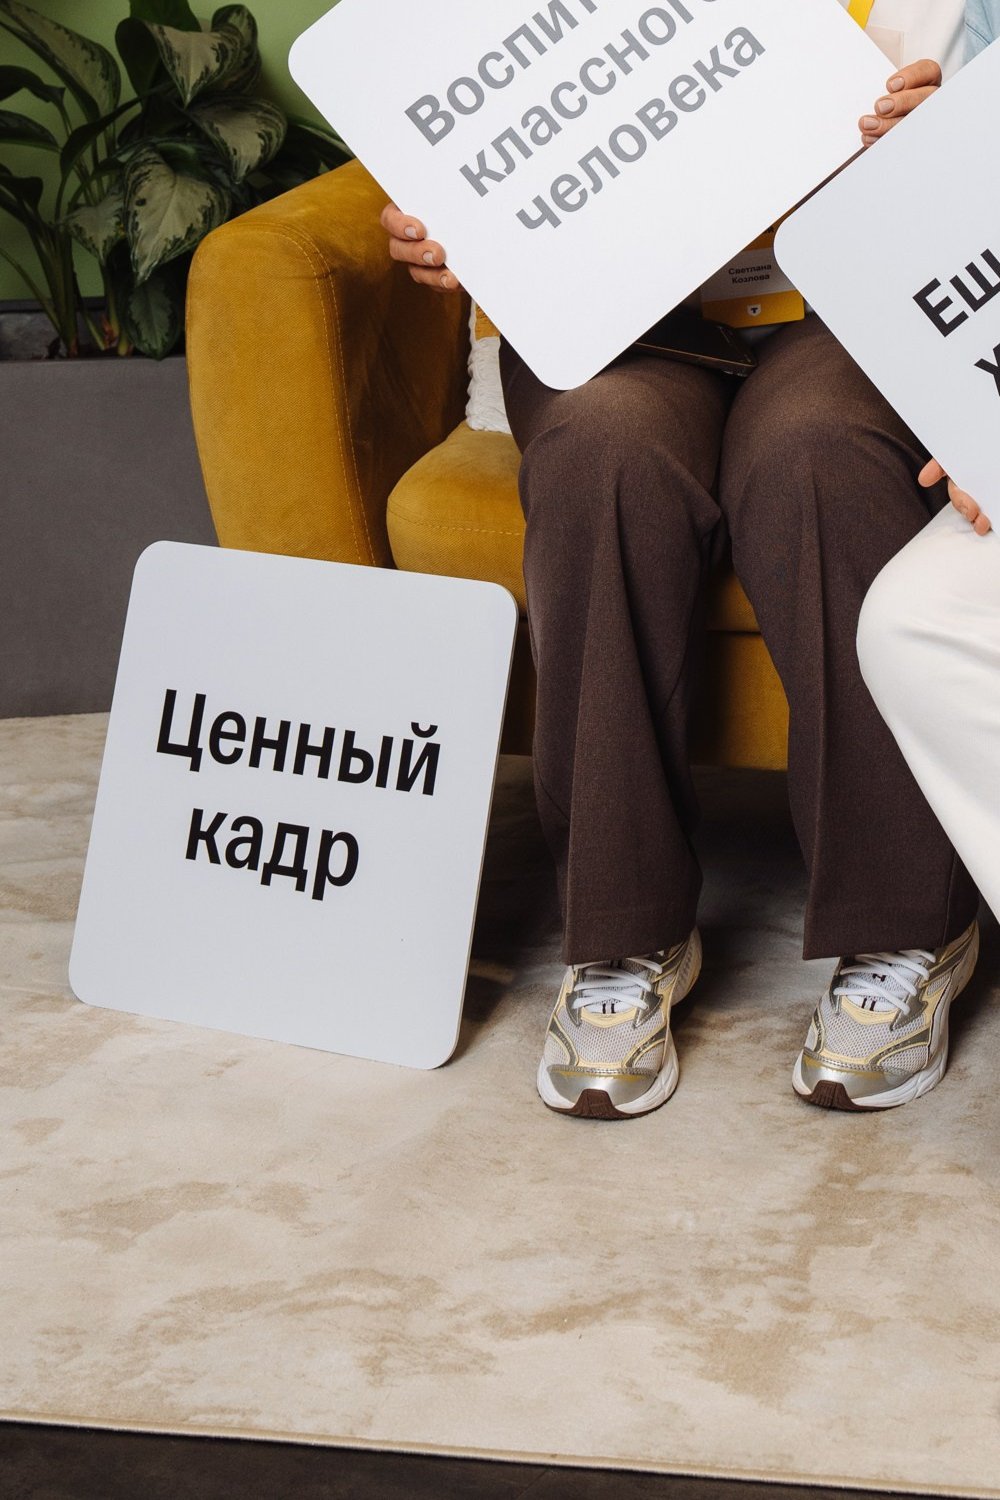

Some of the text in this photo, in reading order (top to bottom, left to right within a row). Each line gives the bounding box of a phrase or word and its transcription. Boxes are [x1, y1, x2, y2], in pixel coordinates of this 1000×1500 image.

[515, 26, 766, 230] человека
[728, 263, 772, 275] Светлана
[731, 274, 770, 284] Козлова
[156, 688, 441, 797] Ценный
[185, 807, 360, 902] кадр
